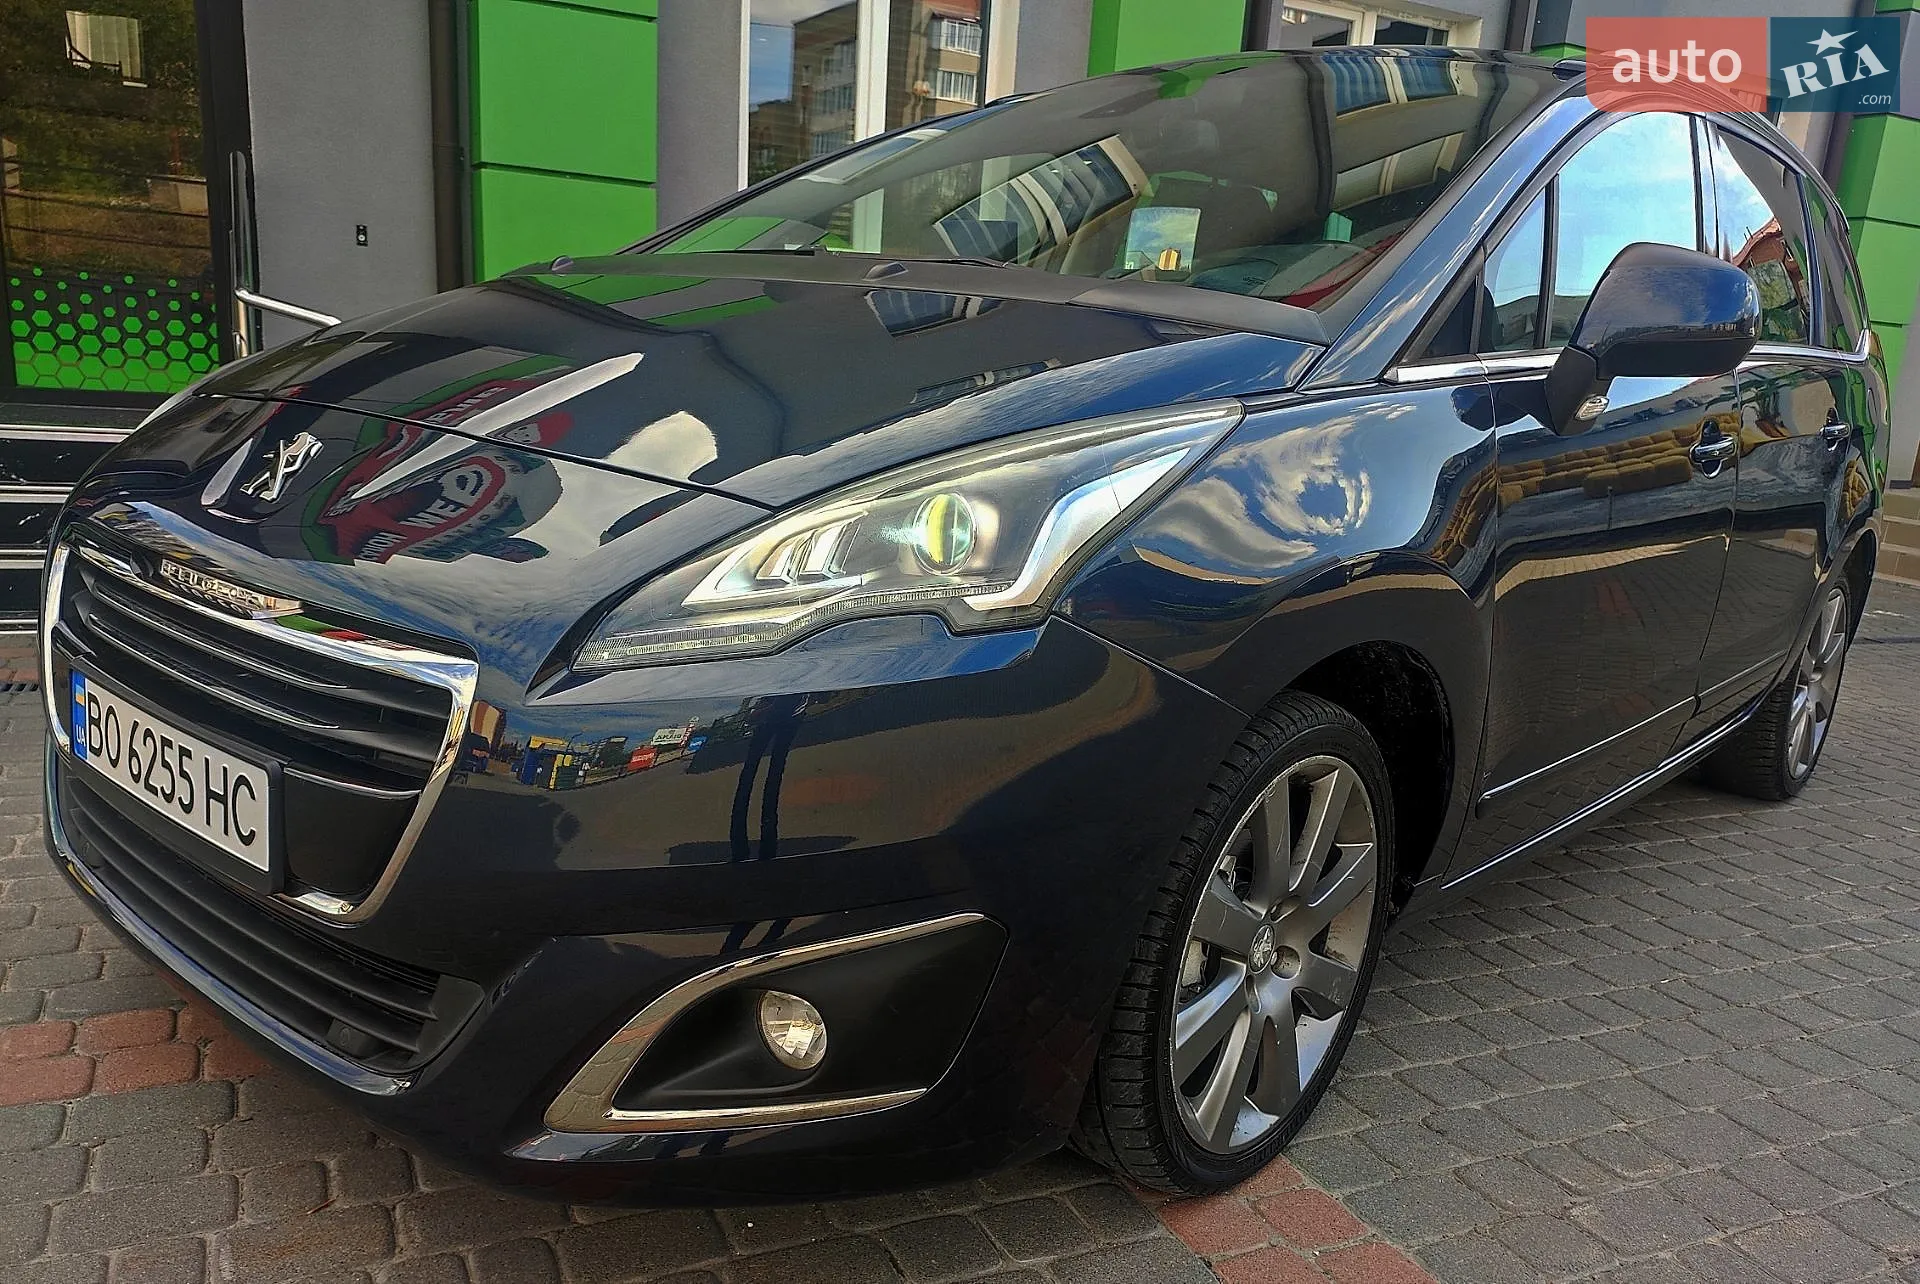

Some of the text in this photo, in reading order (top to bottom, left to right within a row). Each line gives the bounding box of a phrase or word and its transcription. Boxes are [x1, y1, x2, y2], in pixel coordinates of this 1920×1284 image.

[75, 724, 86, 747] UA
[87, 691, 256, 847] BO 6255 HC
